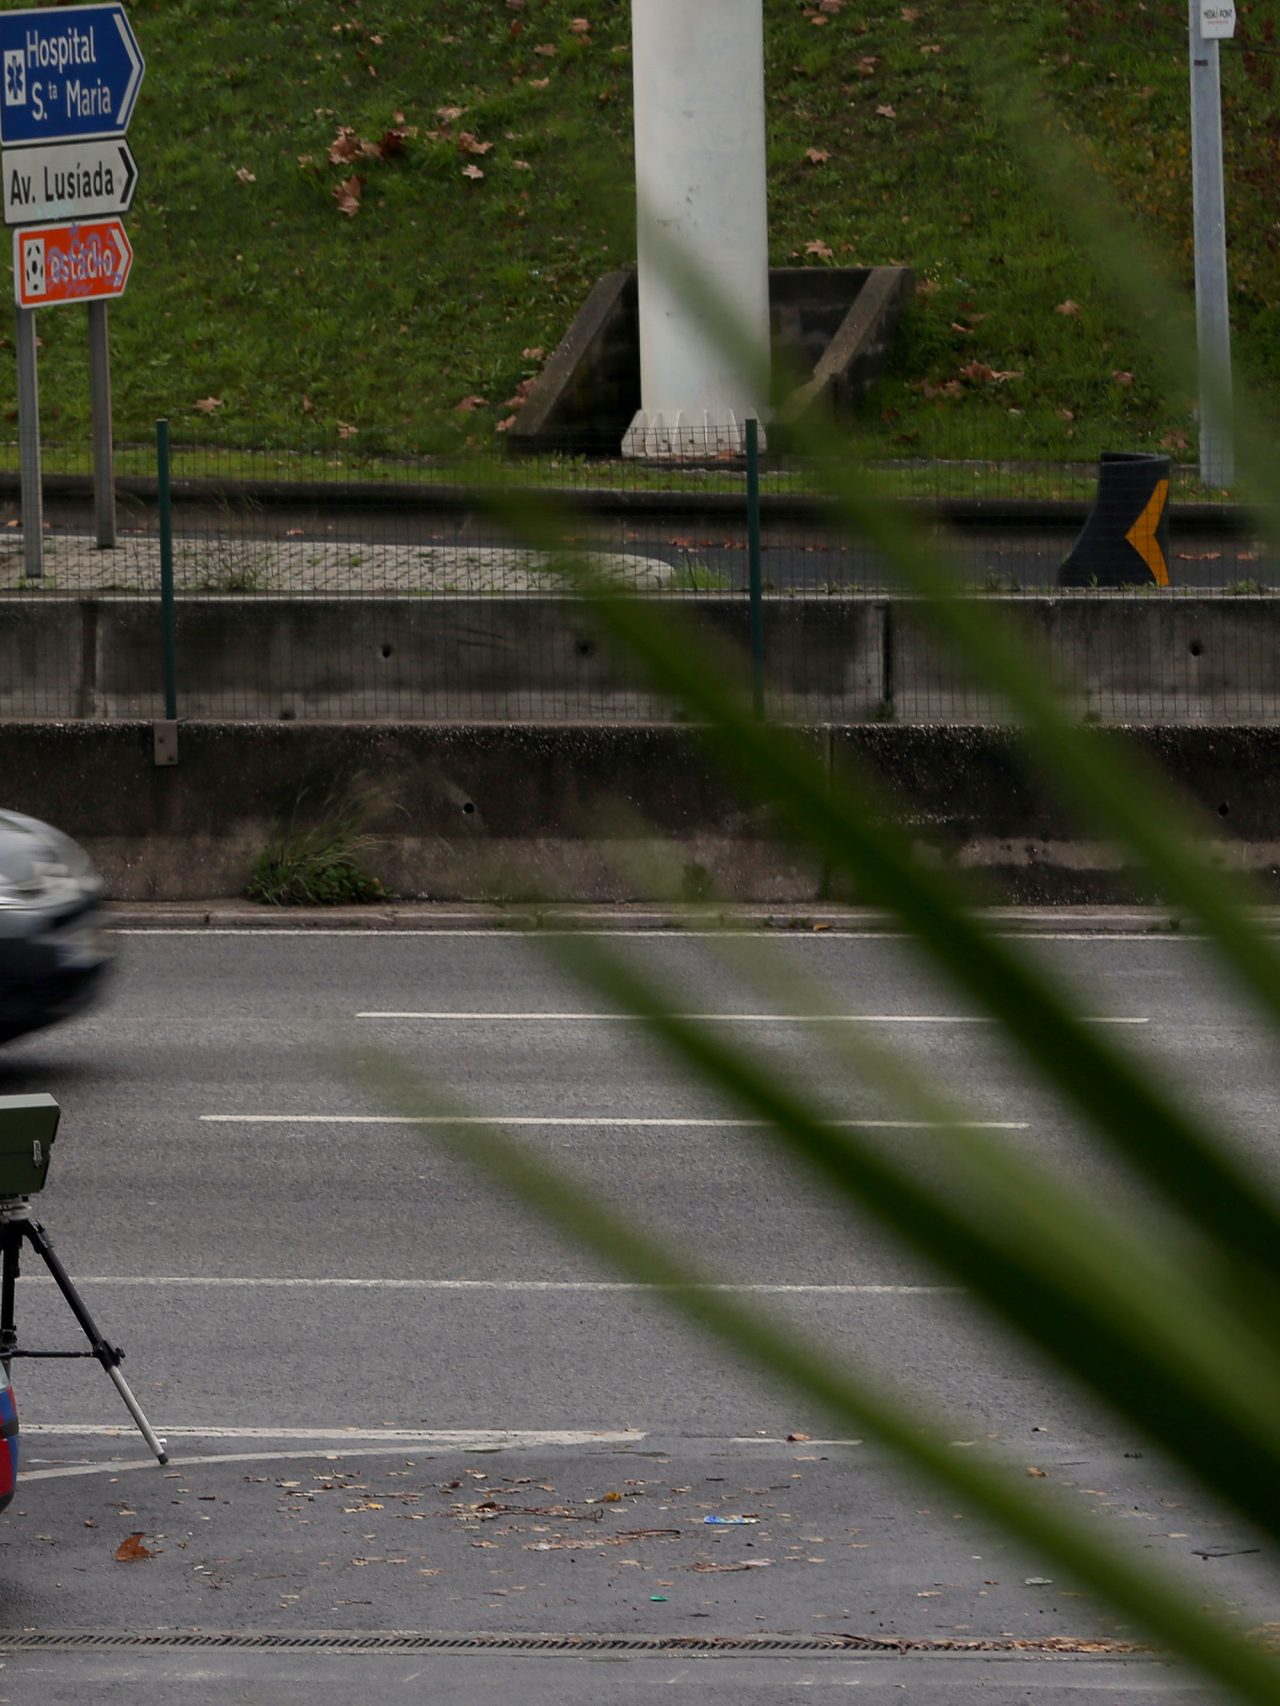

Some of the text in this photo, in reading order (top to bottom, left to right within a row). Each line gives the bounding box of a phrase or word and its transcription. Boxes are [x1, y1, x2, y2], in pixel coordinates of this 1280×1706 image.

[26, 25, 96, 73] Hospital
[66, 79, 112, 118] Maria
[10, 161, 114, 205] Av. Lusíada
